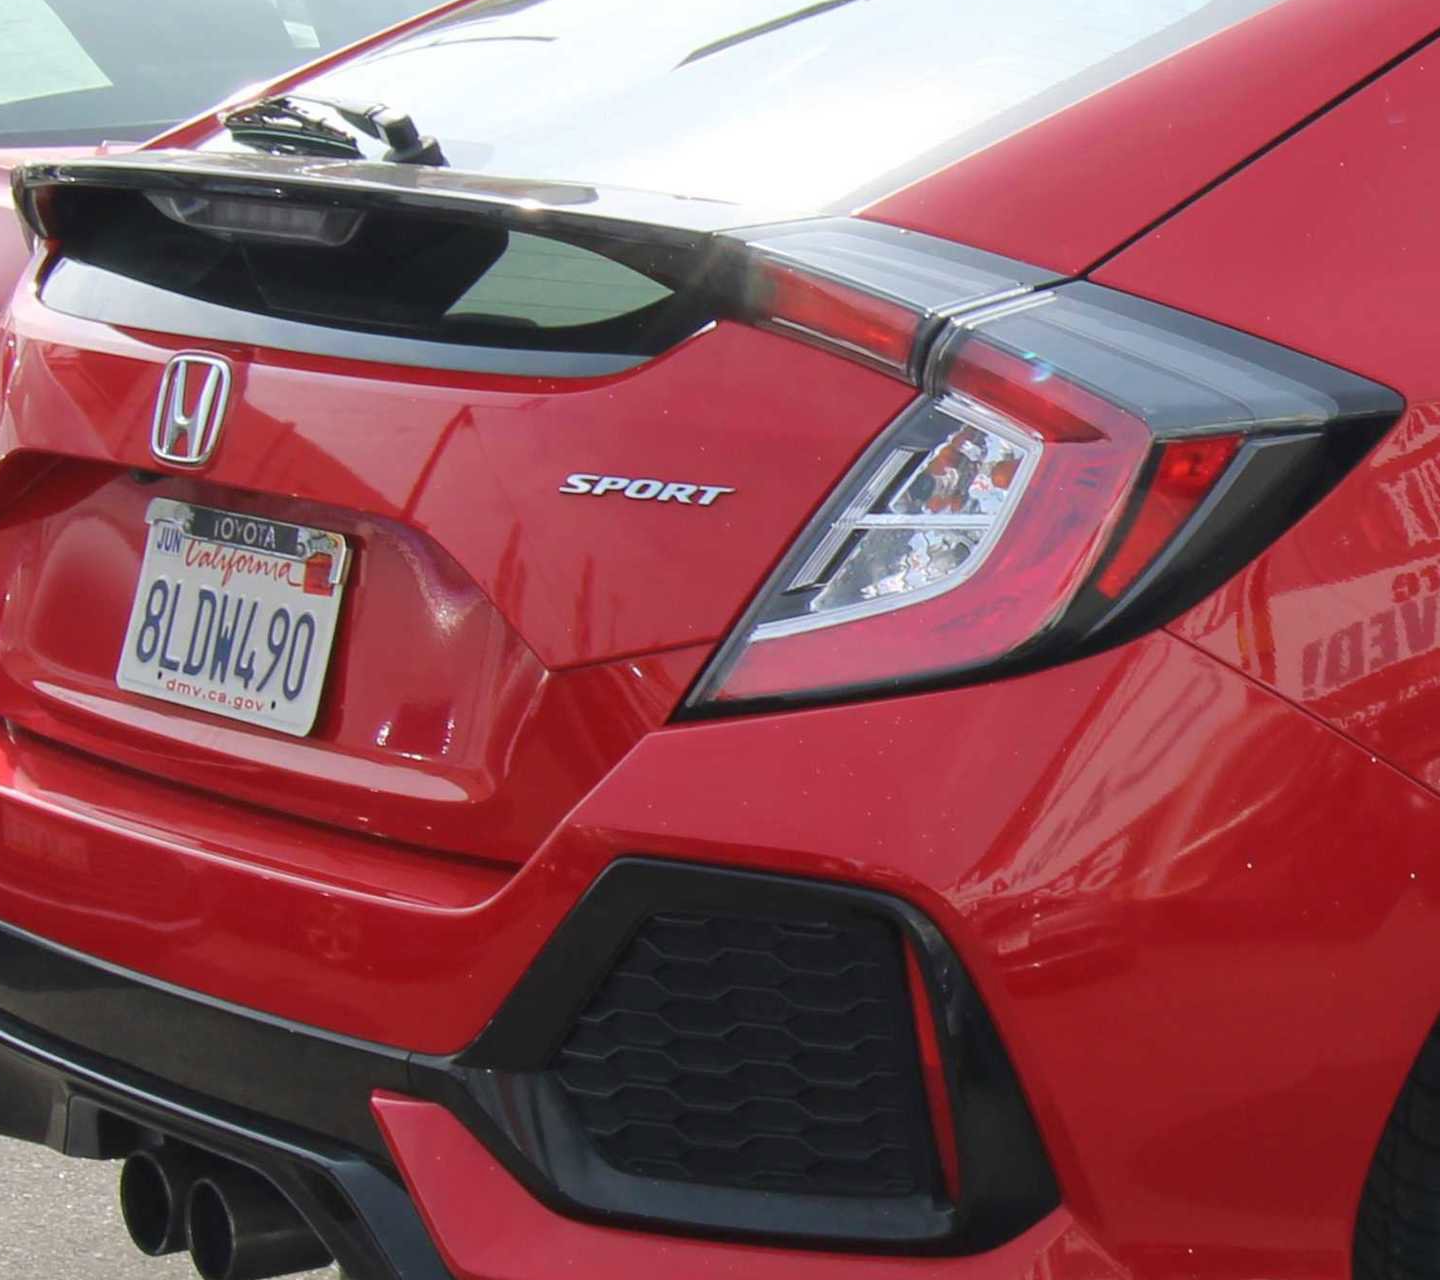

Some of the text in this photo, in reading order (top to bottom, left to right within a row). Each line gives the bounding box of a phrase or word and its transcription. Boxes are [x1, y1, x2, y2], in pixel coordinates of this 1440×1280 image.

[560, 473, 736, 509] SPORT
[157, 527, 183, 554] JUN
[213, 518, 277, 551] TOYOTA
[185, 538, 305, 588] California
[136, 579, 316, 701] 8LDW490
[165, 678, 266, 713] dmv.ca.gov
